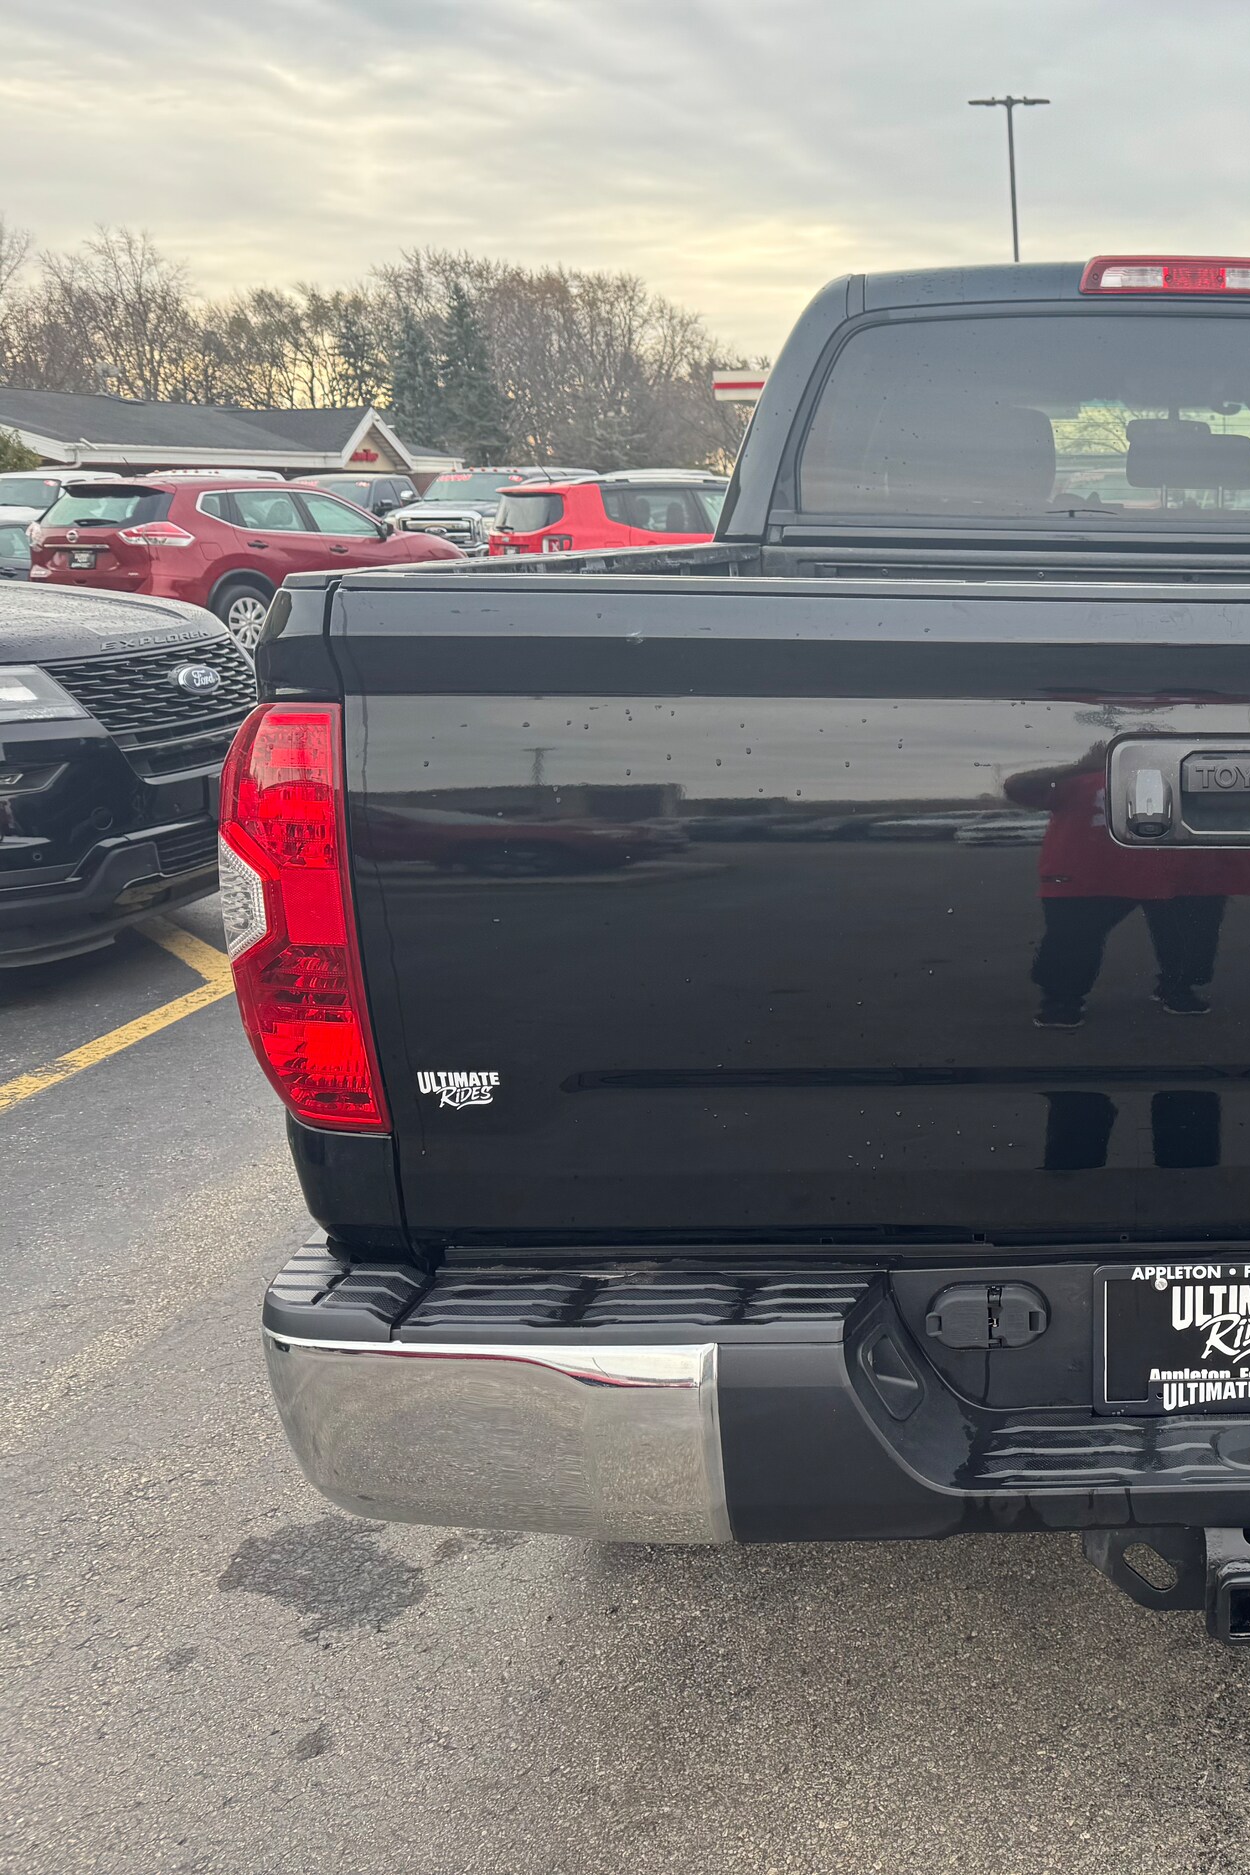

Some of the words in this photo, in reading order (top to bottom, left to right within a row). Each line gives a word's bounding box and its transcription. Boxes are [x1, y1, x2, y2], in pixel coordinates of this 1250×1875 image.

[100, 631, 209, 651] EXPLORER
[192, 670, 218, 687] Ford
[417, 1071, 500, 1094] ULTIMATE
[1131, 1266, 1221, 1281] APPLETON
